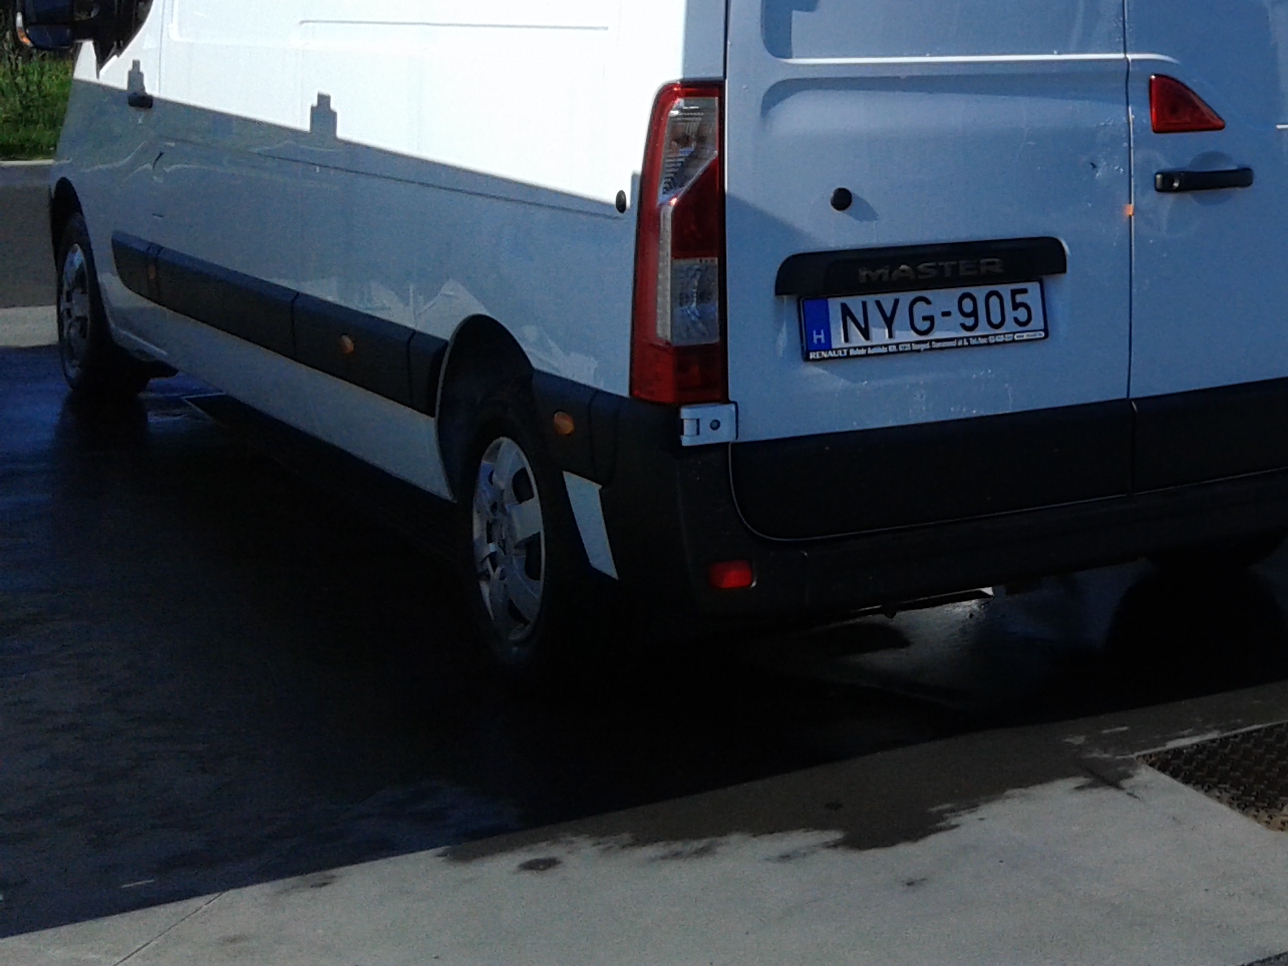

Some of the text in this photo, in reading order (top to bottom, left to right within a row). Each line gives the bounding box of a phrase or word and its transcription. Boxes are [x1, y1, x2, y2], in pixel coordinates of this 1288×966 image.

[858, 257, 1004, 284] MASTER
[812, 329, 825, 345] H
[840, 287, 1033, 344] NYG-905
